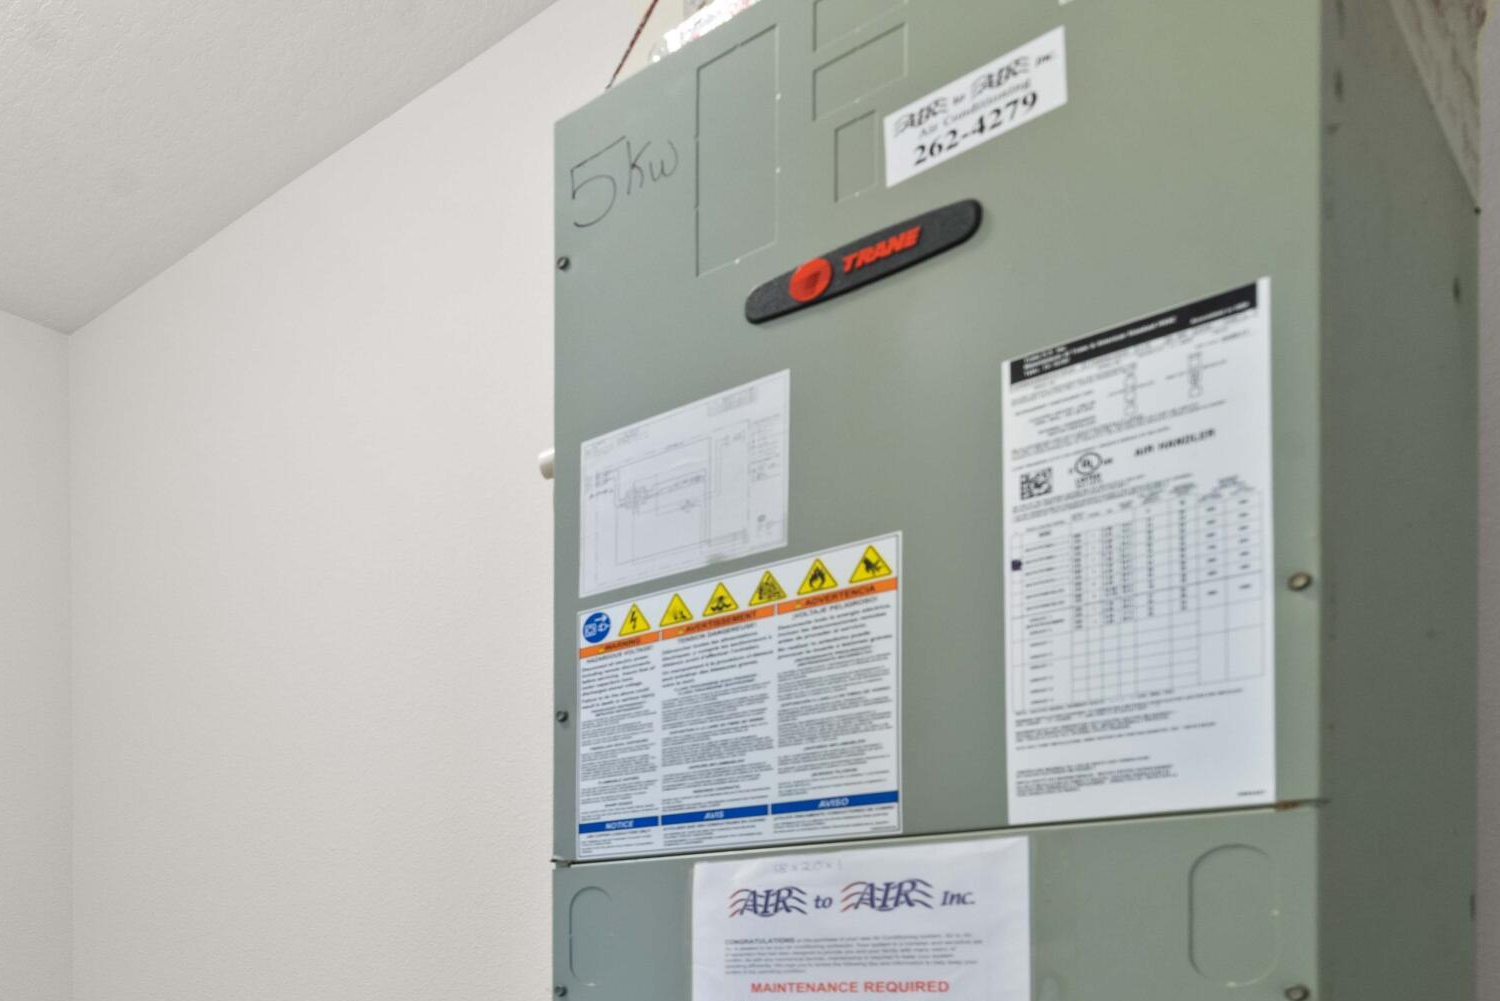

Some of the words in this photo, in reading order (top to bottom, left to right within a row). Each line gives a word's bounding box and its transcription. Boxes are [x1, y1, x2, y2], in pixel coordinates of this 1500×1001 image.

[913, 90, 1039, 167] 262-4279
[841, 225, 922, 274] TRANE
[817, 797, 850, 808] AVISO
[703, 810, 725, 820] AVIS
[604, 819, 635, 830] NOTICE
[733, 886, 804, 918] AIR
[813, 895, 833, 910] to
[845, 879, 930, 912] AIR
[940, 890, 976, 907] Inc.
[750, 981, 859, 993] MAINTENANCE
[863, 980, 950, 993] REQUIRED
